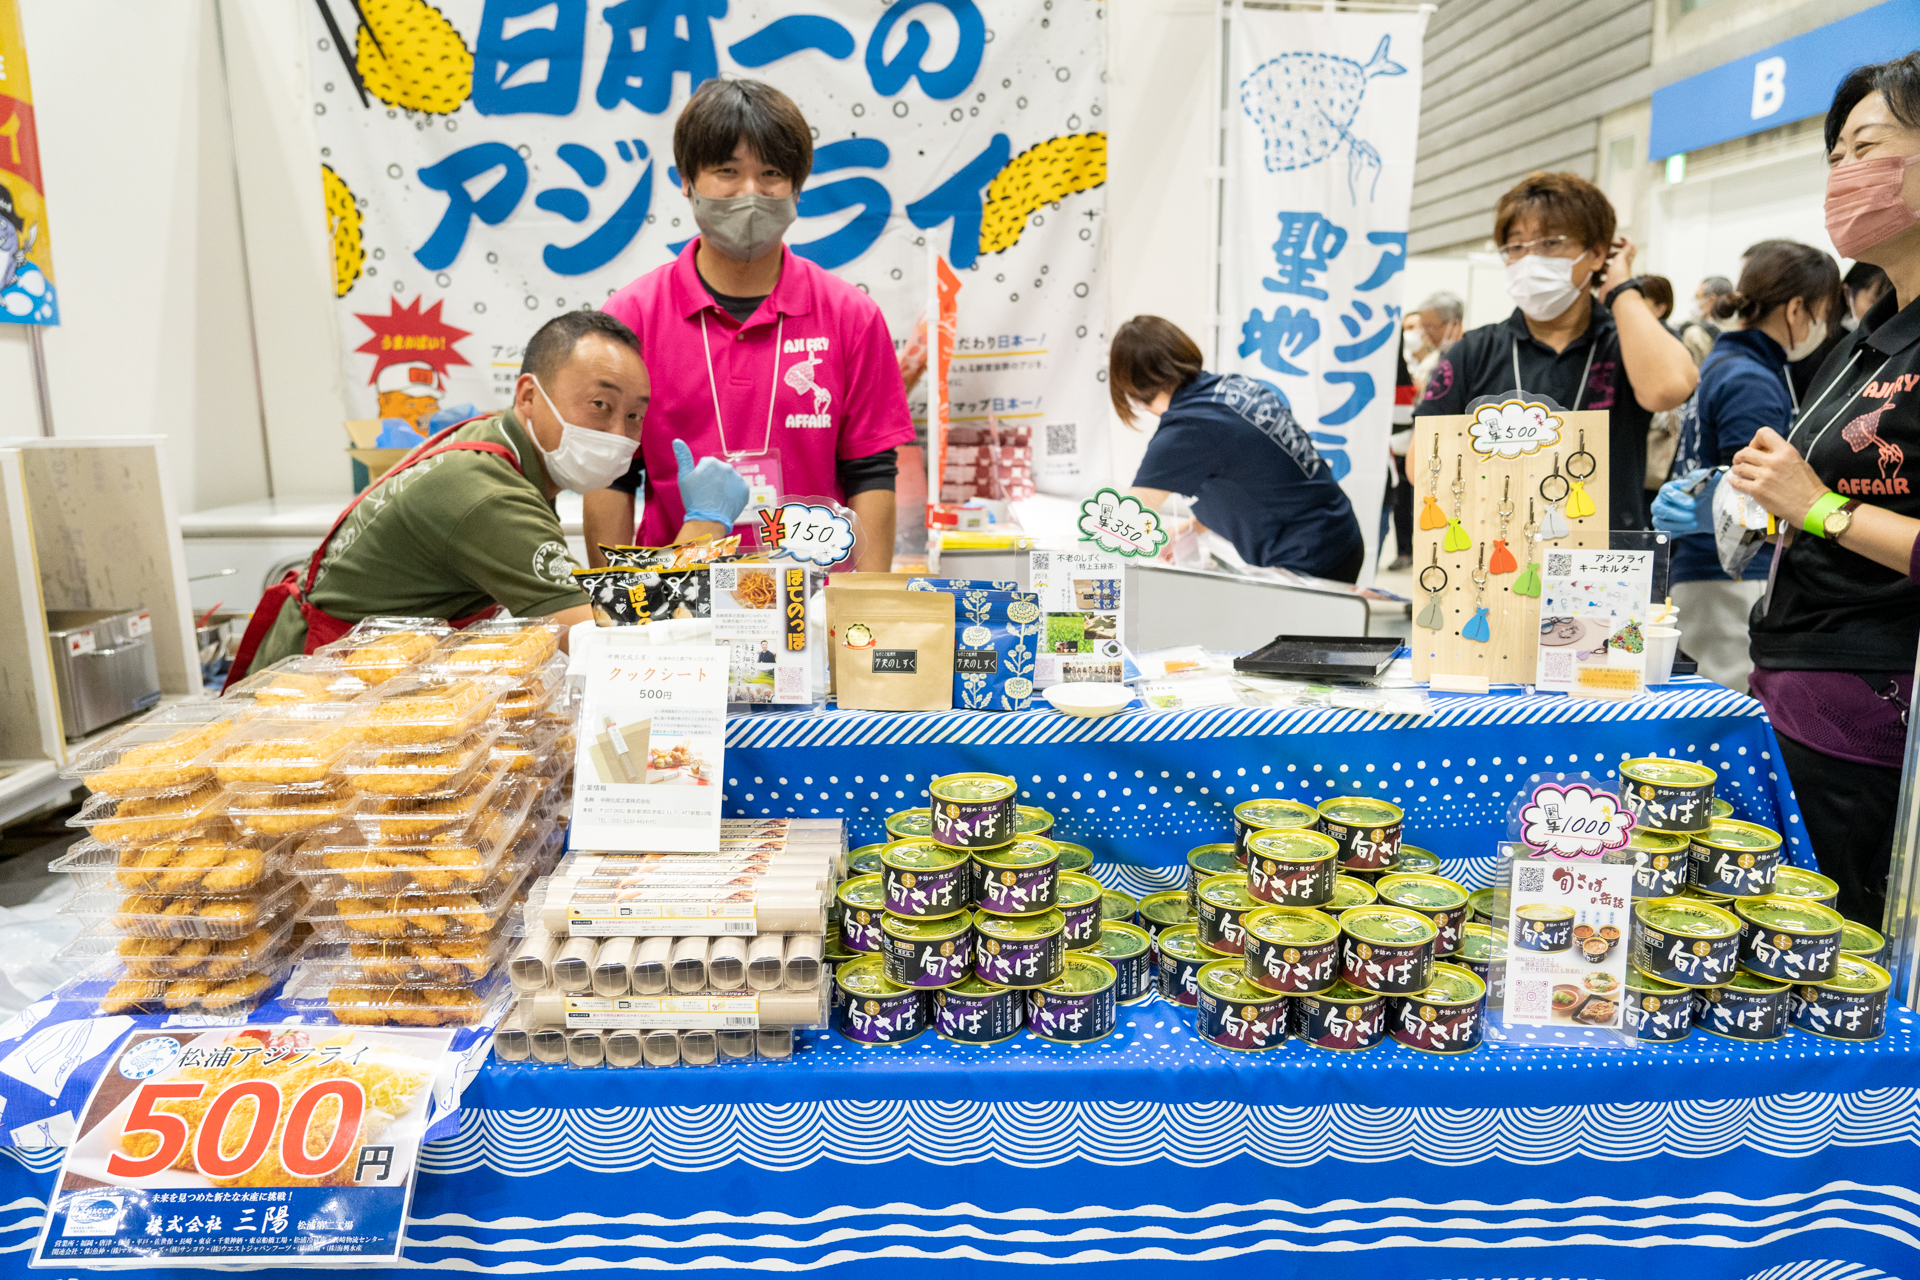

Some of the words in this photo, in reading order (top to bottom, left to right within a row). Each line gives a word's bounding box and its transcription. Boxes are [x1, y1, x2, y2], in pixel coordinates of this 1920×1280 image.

[1751, 56, 1786, 120] B
[414, 132, 1011, 275] アジライ
[1238, 211, 1348, 408] 聖地
[783, 338, 805, 353] AJI
[806, 337, 829, 351] FRY
[1893, 373, 1920, 394] RY
[785, 414, 831, 428] AFFAIR
[1837, 478, 1911, 495] AFFAIR
[1579, 564, 1640, 574] キーホルダー
[1595, 554, 1646, 564] アジフライ
[786, 568, 806, 651] ぽてのっぽ
[608, 666, 708, 682] クックシート
[639, 689, 672, 700] 500円
[935, 802, 1001, 845] 旬さば
[1624, 782, 1700, 828] 旬さば
[887, 870, 957, 914] 旬さば
[984, 870, 1054, 912] 旬さば
[1250, 856, 1319, 903] 旬さば
[1591, 892, 1624, 908] の缶詰
[1521, 921, 1570, 950] 旬さば
[1751, 930, 1836, 979] 旬さば
[976, 935, 1044, 984] 旬さば
[1263, 946, 1337, 991] 旬さば
[1343, 939, 1418, 989] 旬さば
[848, 999, 919, 1041] 旬さば
[1400, 1002, 1478, 1049] 旬さば
[178, 1046, 371, 1068] 松浦アジフライ
[107, 1080, 365, 1178] 500
[354, 1146, 395, 1182] 円
[151, 1191, 294, 1203] 未来を見つめた新たな水産に挑戦！
[145, 1214, 222, 1237] 株式会社
[233, 1205, 290, 1234] 三陽
